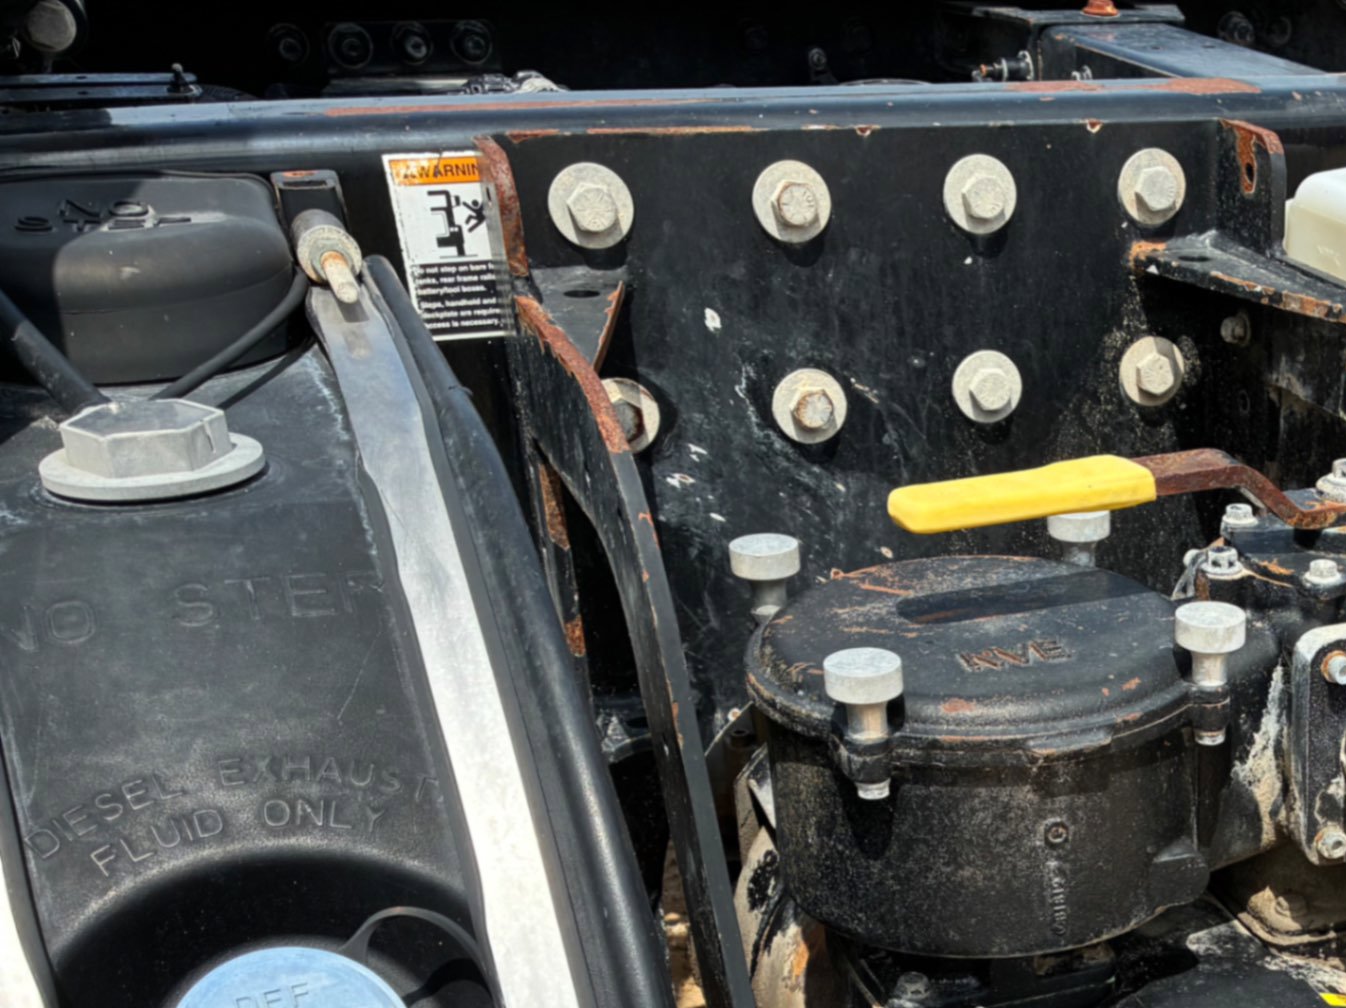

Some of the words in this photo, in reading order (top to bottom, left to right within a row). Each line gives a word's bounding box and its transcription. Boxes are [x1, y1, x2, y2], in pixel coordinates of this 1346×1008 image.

[417, 162, 480, 179] WARNIN
[956, 637, 1073, 673] NVE
[24, 772, 185, 860] DIESEL
[216, 757, 444, 804] EXHAUST
[89, 808, 225, 878] FLUID
[263, 799, 387, 834] ONLY
